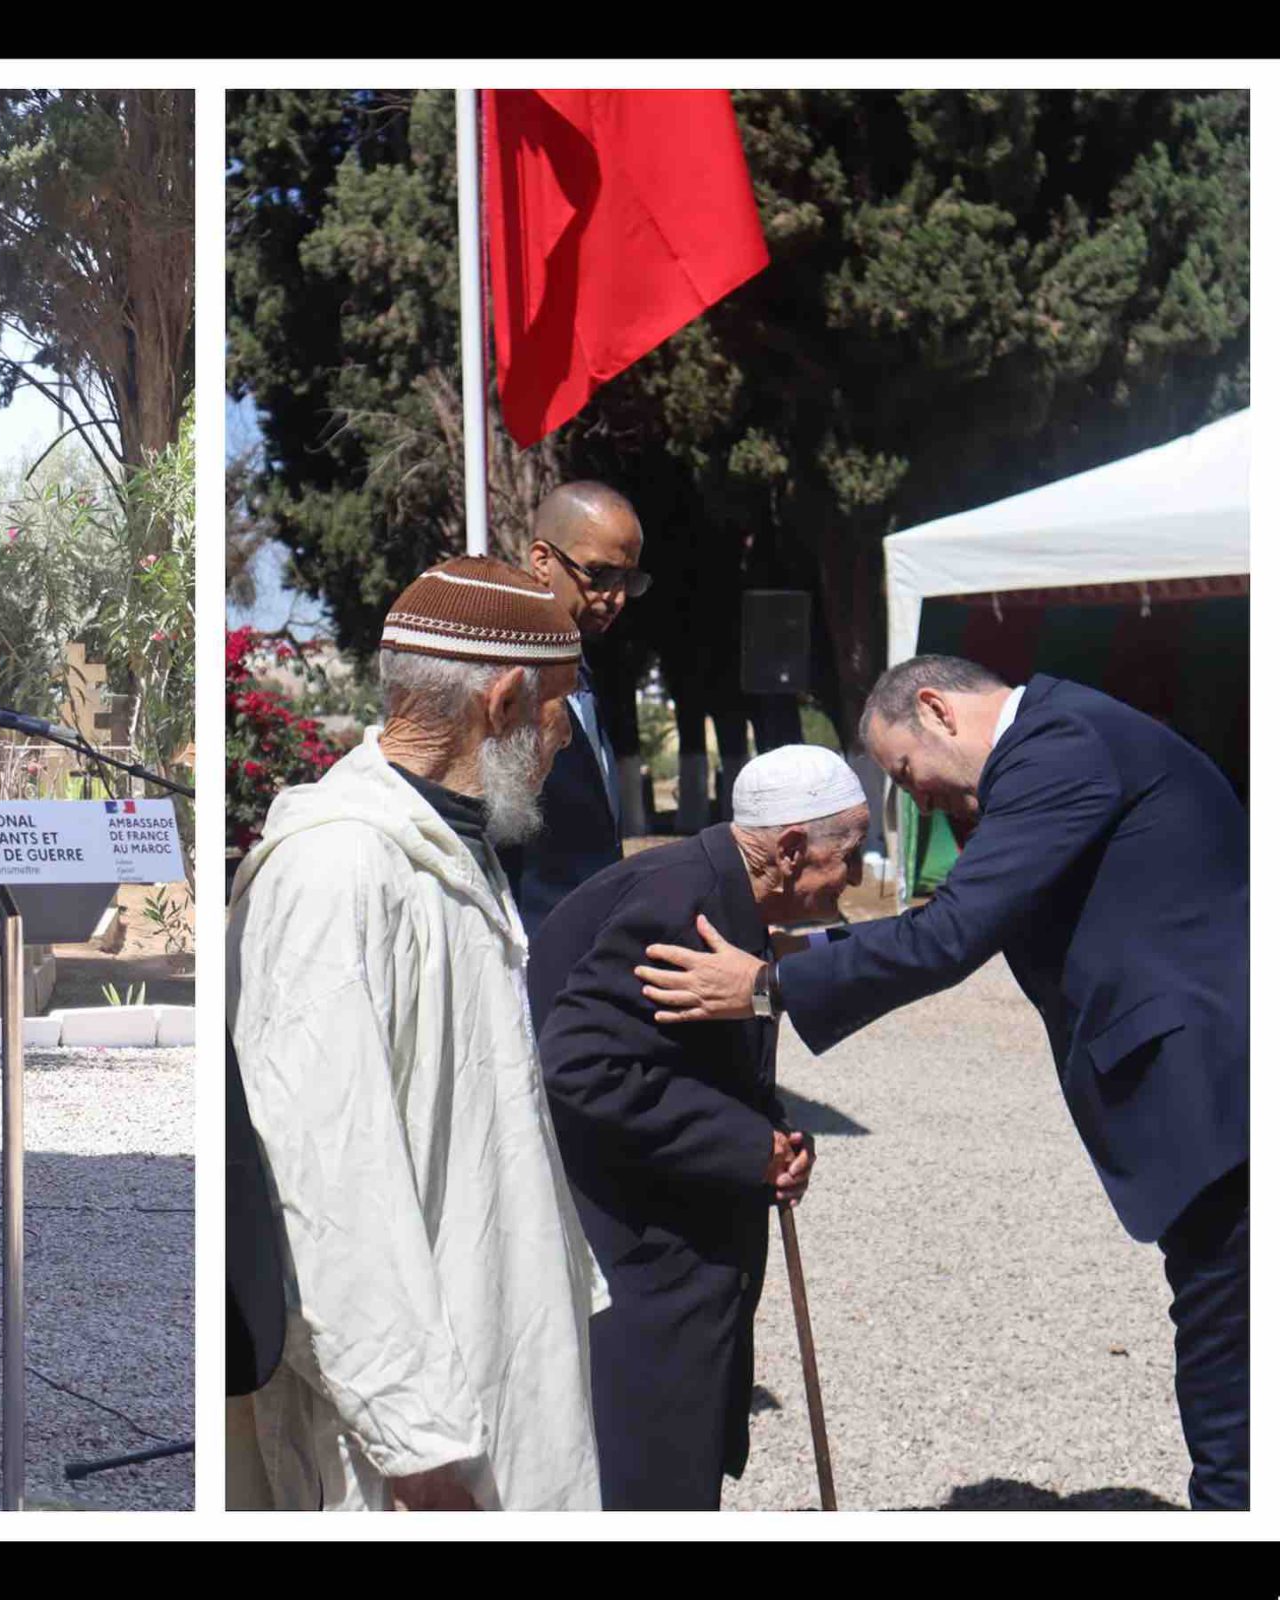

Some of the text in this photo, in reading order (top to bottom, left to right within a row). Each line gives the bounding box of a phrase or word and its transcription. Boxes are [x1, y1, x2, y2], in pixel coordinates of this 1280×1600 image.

[109, 817, 175, 828] AMBASSADE
[41, 831, 59, 845] ET
[110, 831, 170, 841] DE FRANCE
[3, 848, 24, 861] DE
[26, 848, 84, 861] GUERRE
[113, 844, 172, 854] AU MAROC
